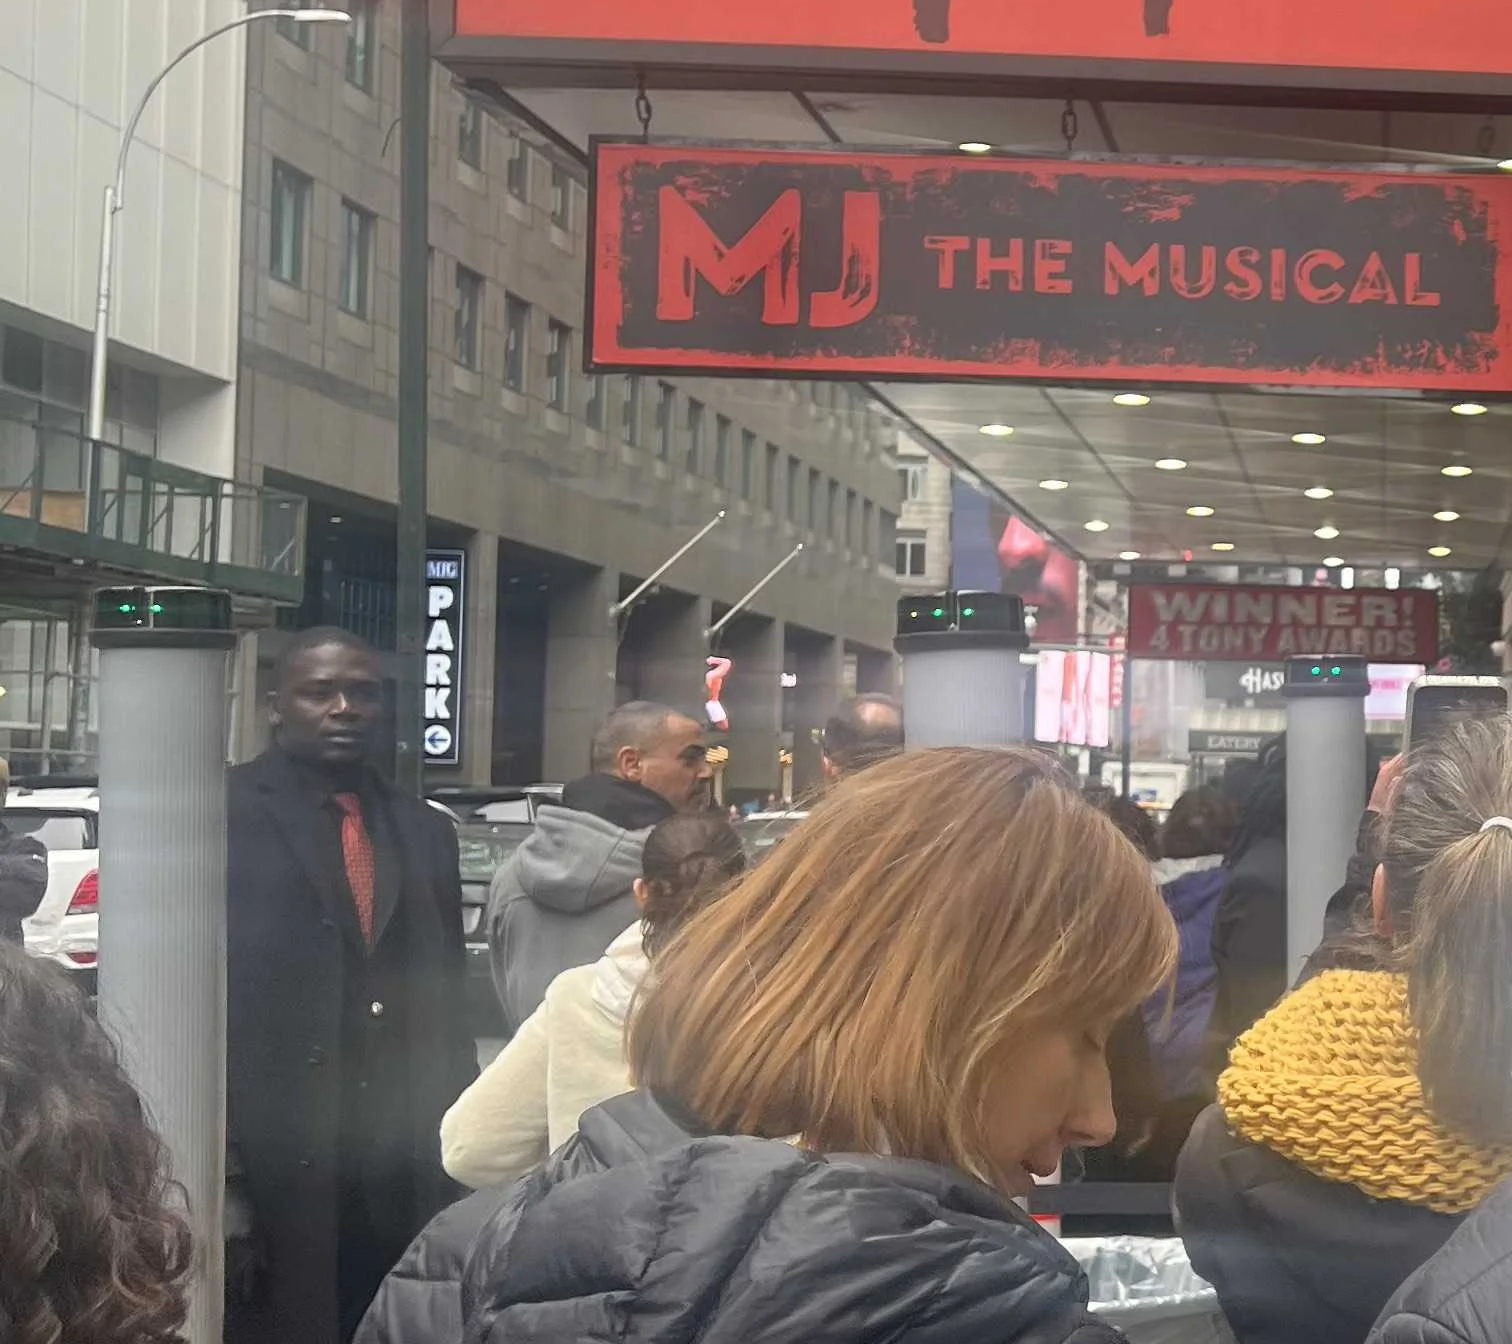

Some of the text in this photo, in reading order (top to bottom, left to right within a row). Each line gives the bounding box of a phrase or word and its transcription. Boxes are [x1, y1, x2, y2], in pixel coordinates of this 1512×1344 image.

[656, 185, 1441, 329] MJ THE MUSICAL
[1153, 591, 1415, 629] WINNER!
[425, 585, 454, 719] PARK
[1150, 624, 1416, 657] 4 TONY AWARDS
[1239, 667, 1285, 694] HAS
